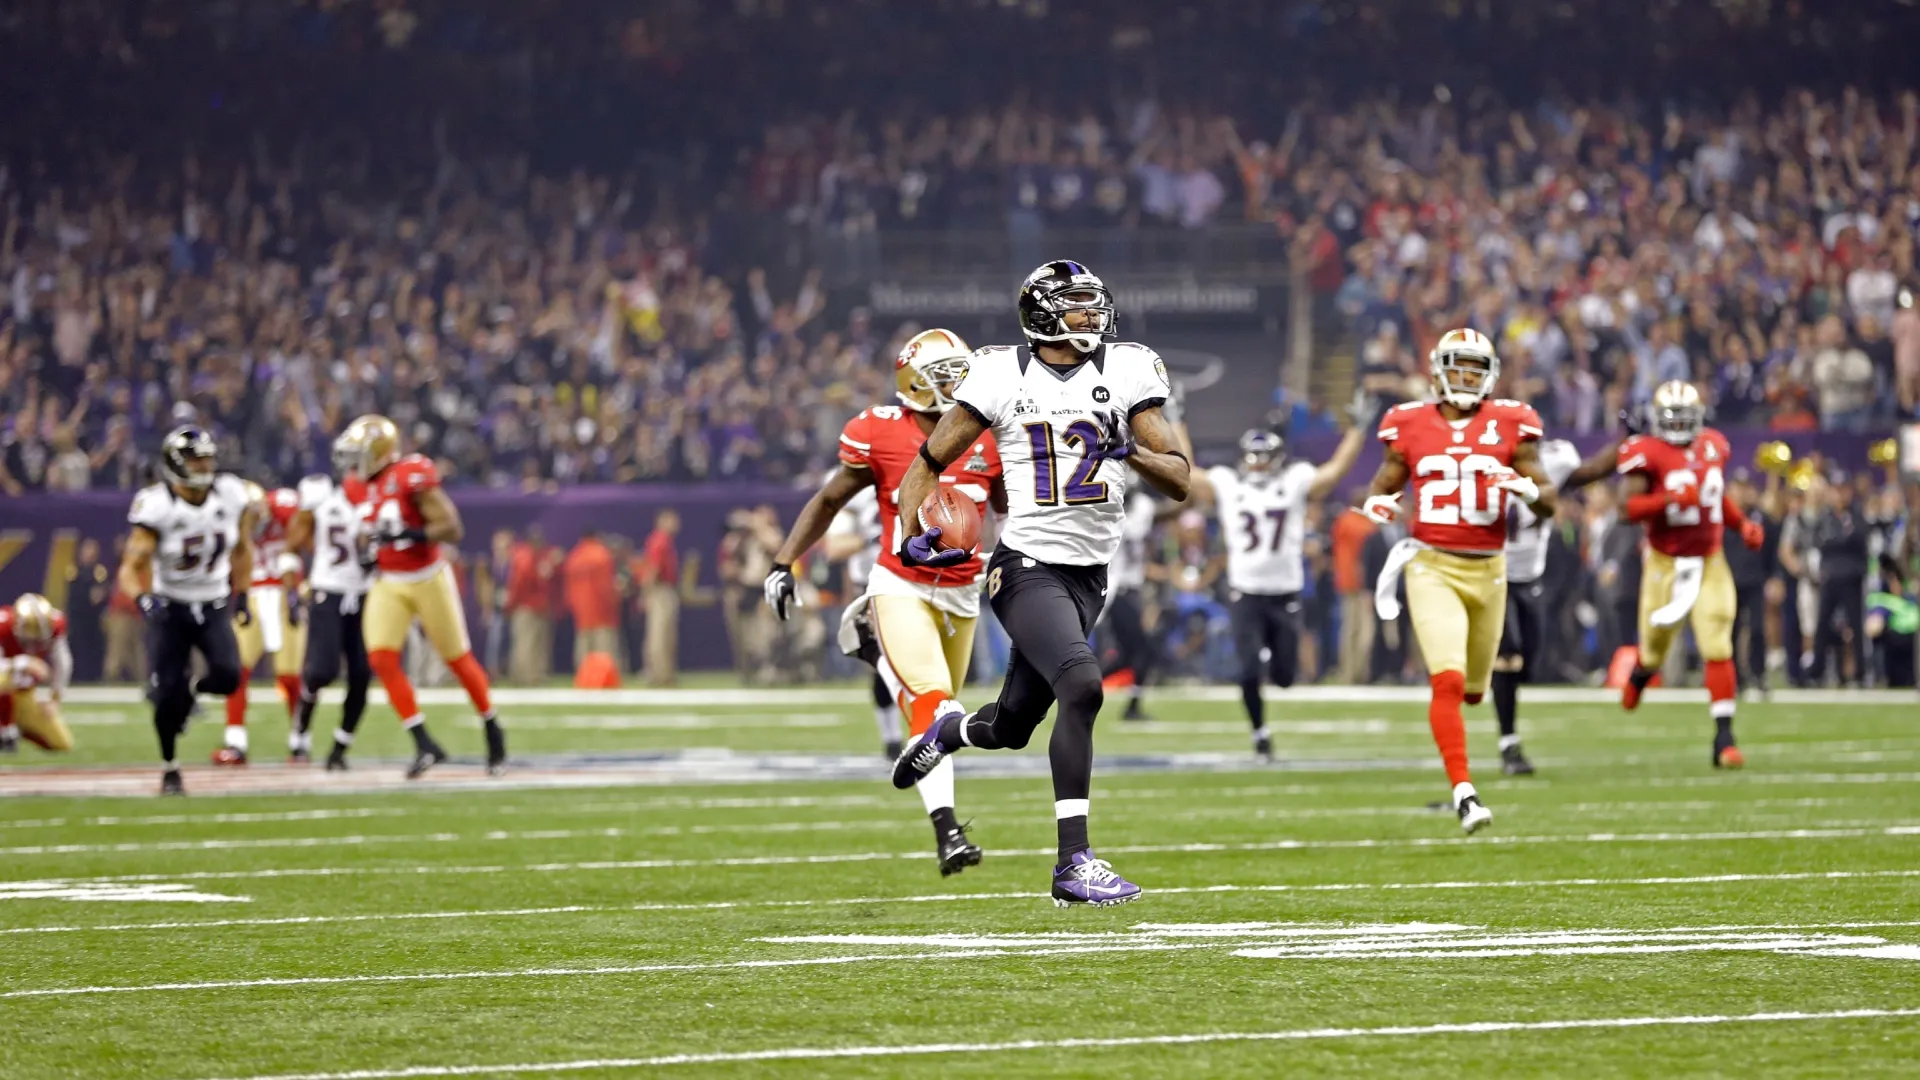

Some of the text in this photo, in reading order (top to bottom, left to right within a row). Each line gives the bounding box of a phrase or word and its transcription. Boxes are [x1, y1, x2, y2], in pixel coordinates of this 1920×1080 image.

[1050, 408, 1084, 416] RAVENS
[1022, 419, 1108, 506] 12
[1416, 454, 1501, 526] 20
[1664, 466, 1724, 527] 24
[173, 531, 225, 573] 51
[1239, 508, 1288, 554] 37
